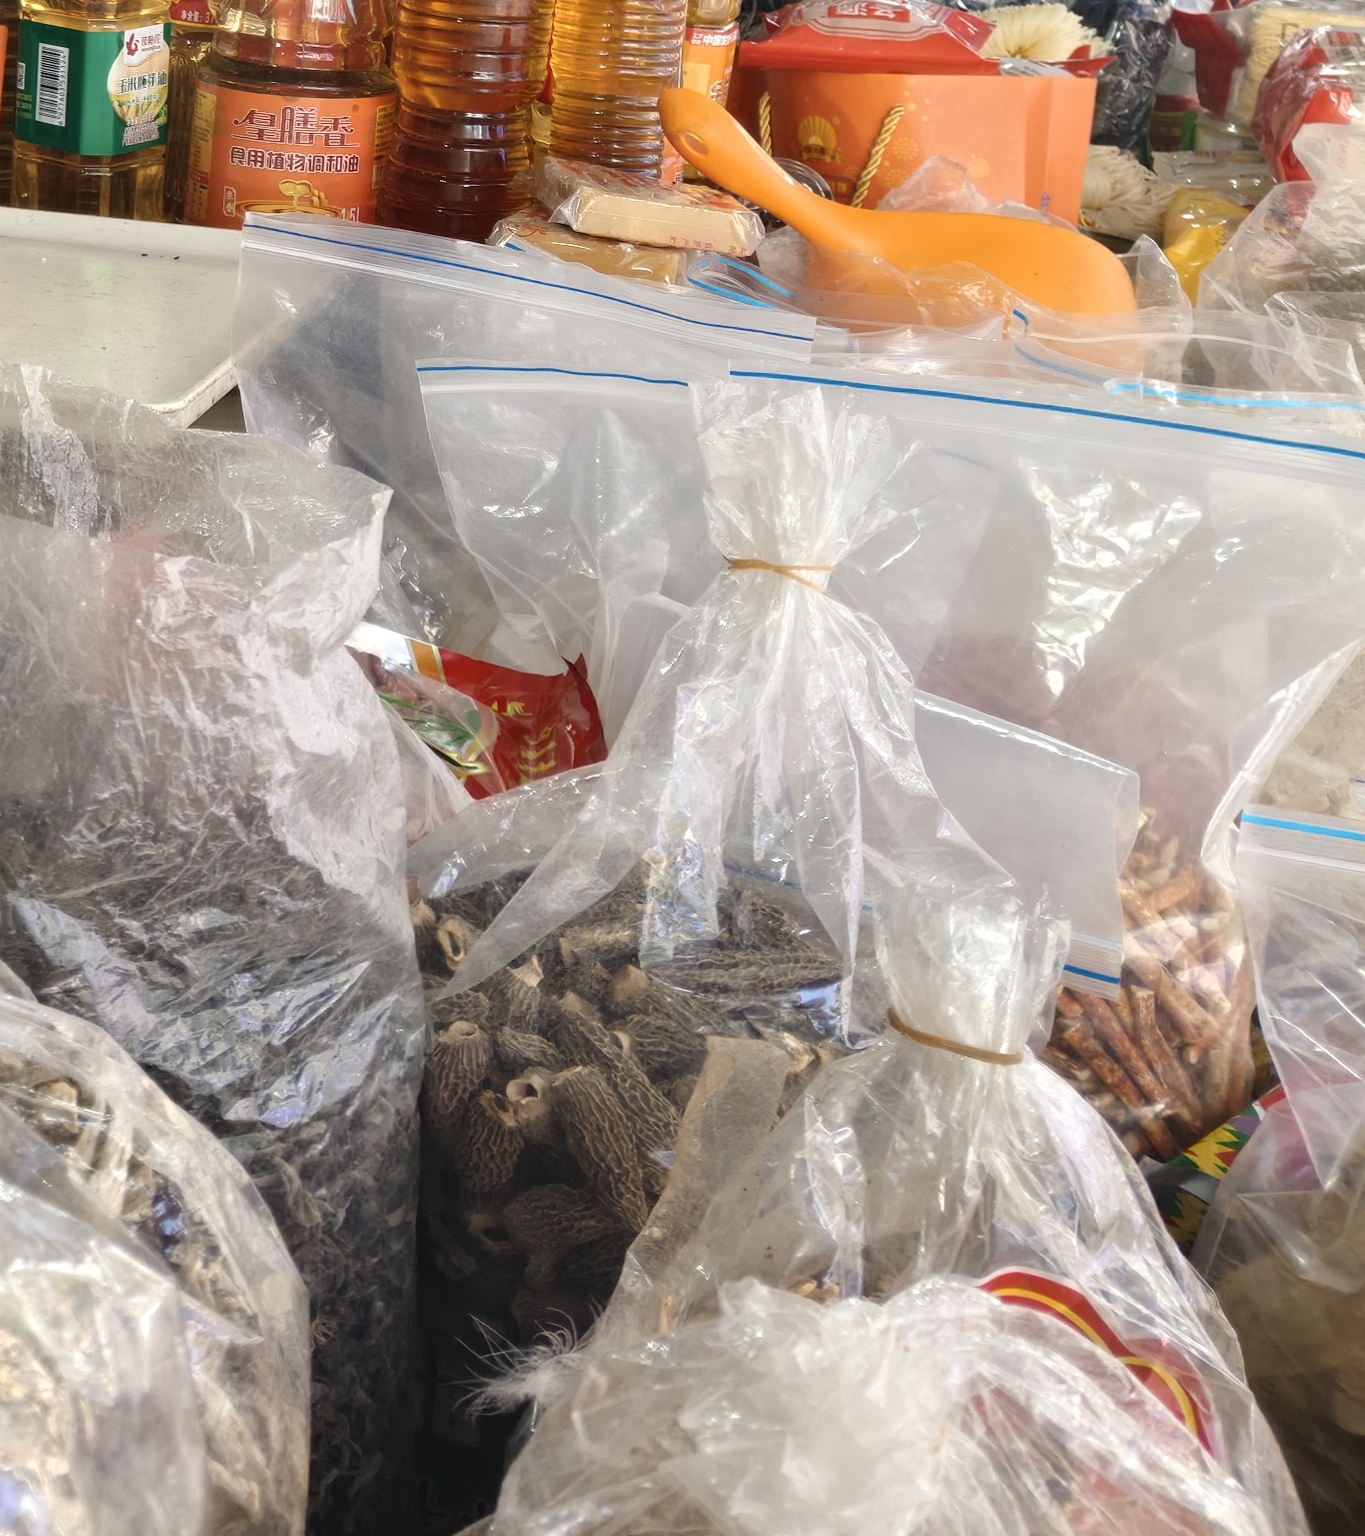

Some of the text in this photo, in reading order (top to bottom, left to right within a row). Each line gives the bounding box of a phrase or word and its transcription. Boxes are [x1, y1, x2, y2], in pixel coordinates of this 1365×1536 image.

[231, 105, 361, 149] 皇膳香
[229, 145, 360, 174] 食用植物调和油
